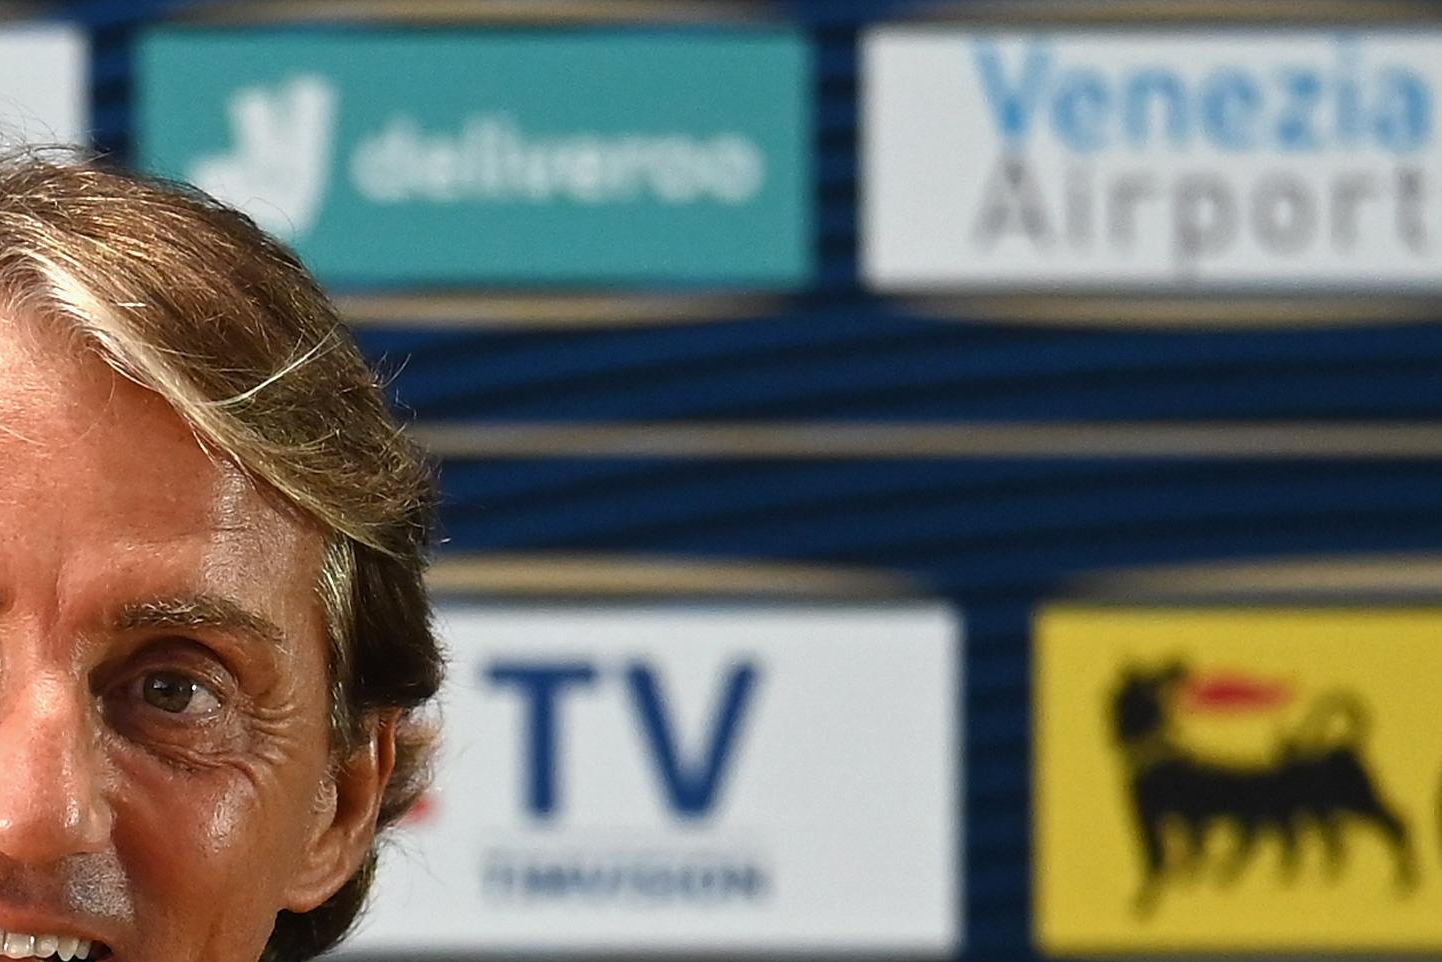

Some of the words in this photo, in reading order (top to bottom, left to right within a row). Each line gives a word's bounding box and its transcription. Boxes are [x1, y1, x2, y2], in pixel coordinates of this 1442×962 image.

[970, 34, 1434, 154] Venezia
[348, 114, 765, 202] deliveroo
[970, 160, 1428, 278] Airport
[480, 657, 764, 825] TV
